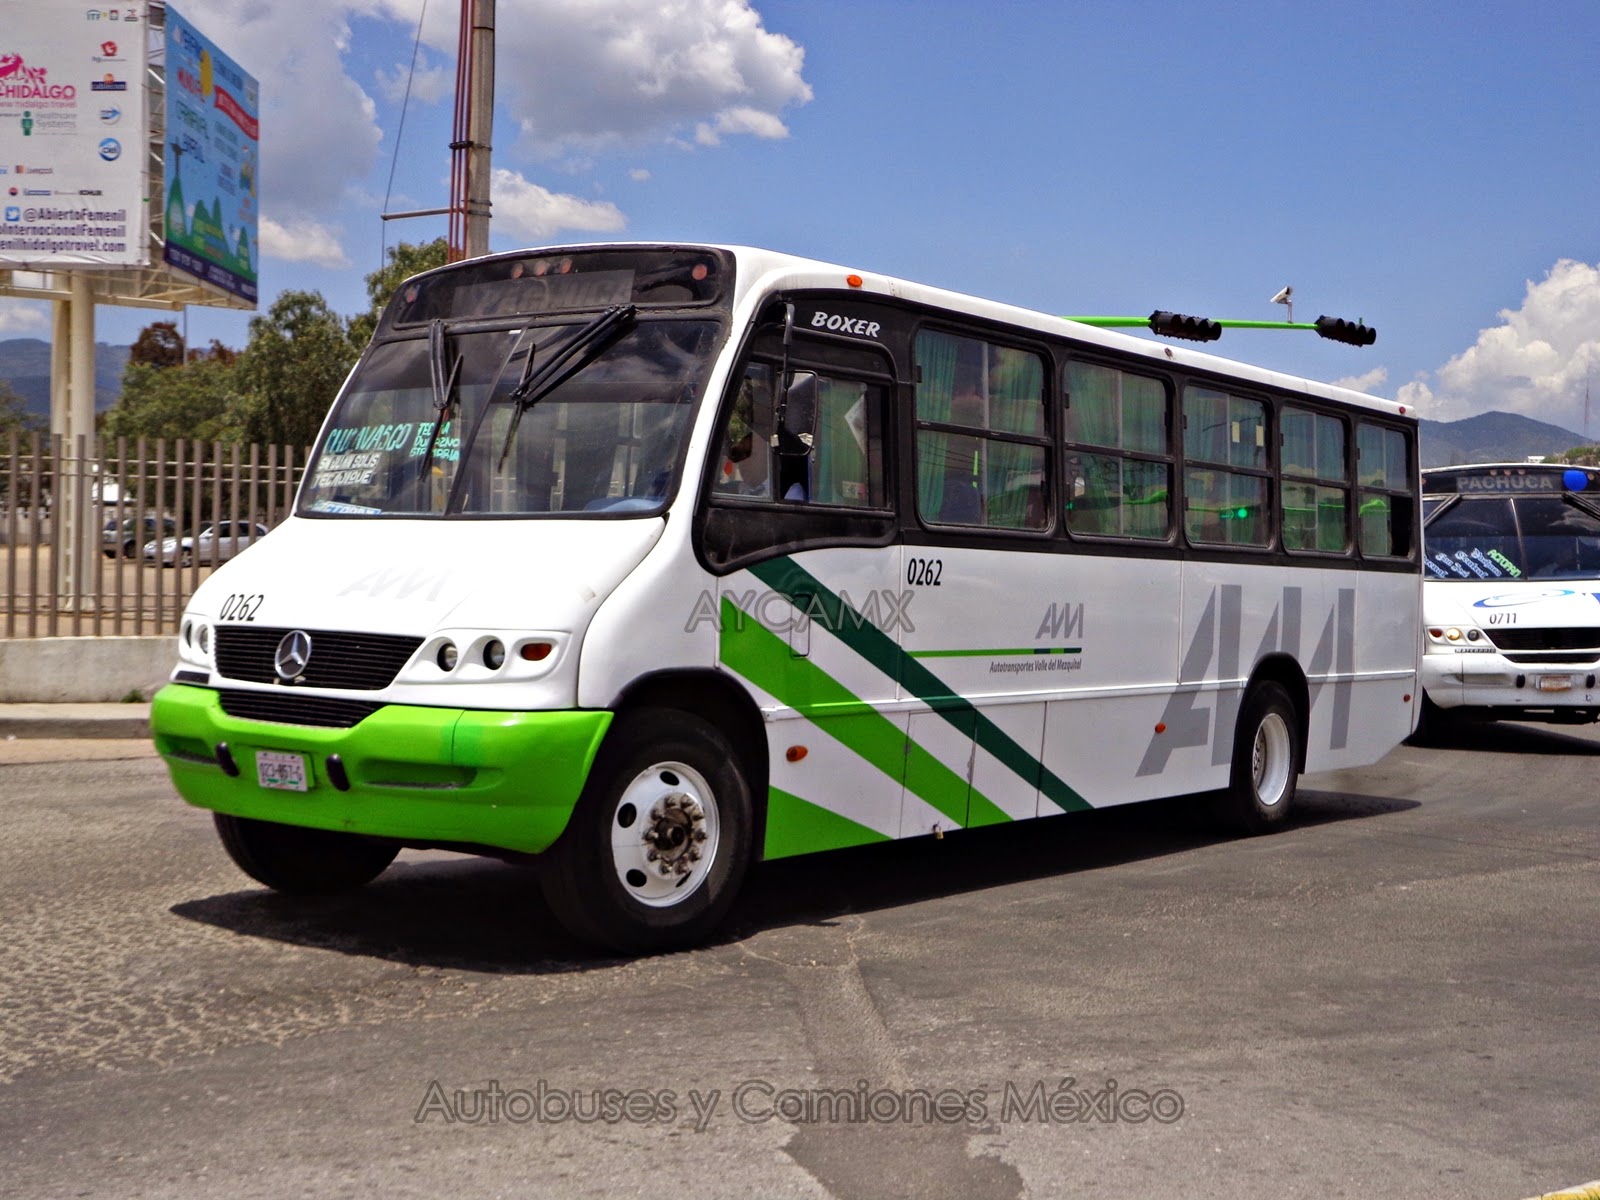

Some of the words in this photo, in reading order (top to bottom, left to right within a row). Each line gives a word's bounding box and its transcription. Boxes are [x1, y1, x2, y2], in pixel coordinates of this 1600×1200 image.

[23, 207, 126, 222] @AbiertoFemenil
[812, 312, 880, 337] BOXER
[350, 453, 380, 469] SOLIS
[1459, 475, 1553, 489] PACHUCA
[907, 558, 943, 586] 0262
[1487, 549, 1522, 578] ACTOPAN
[220, 594, 265, 621] 0262
[1490, 613, 1516, 624] 0711
[990, 661, 1034, 675] Autotransportes
[1034, 659, 1048, 672] Valle
[1048, 658, 1056, 671] del
[1056, 657, 1082, 672] Mezquital
